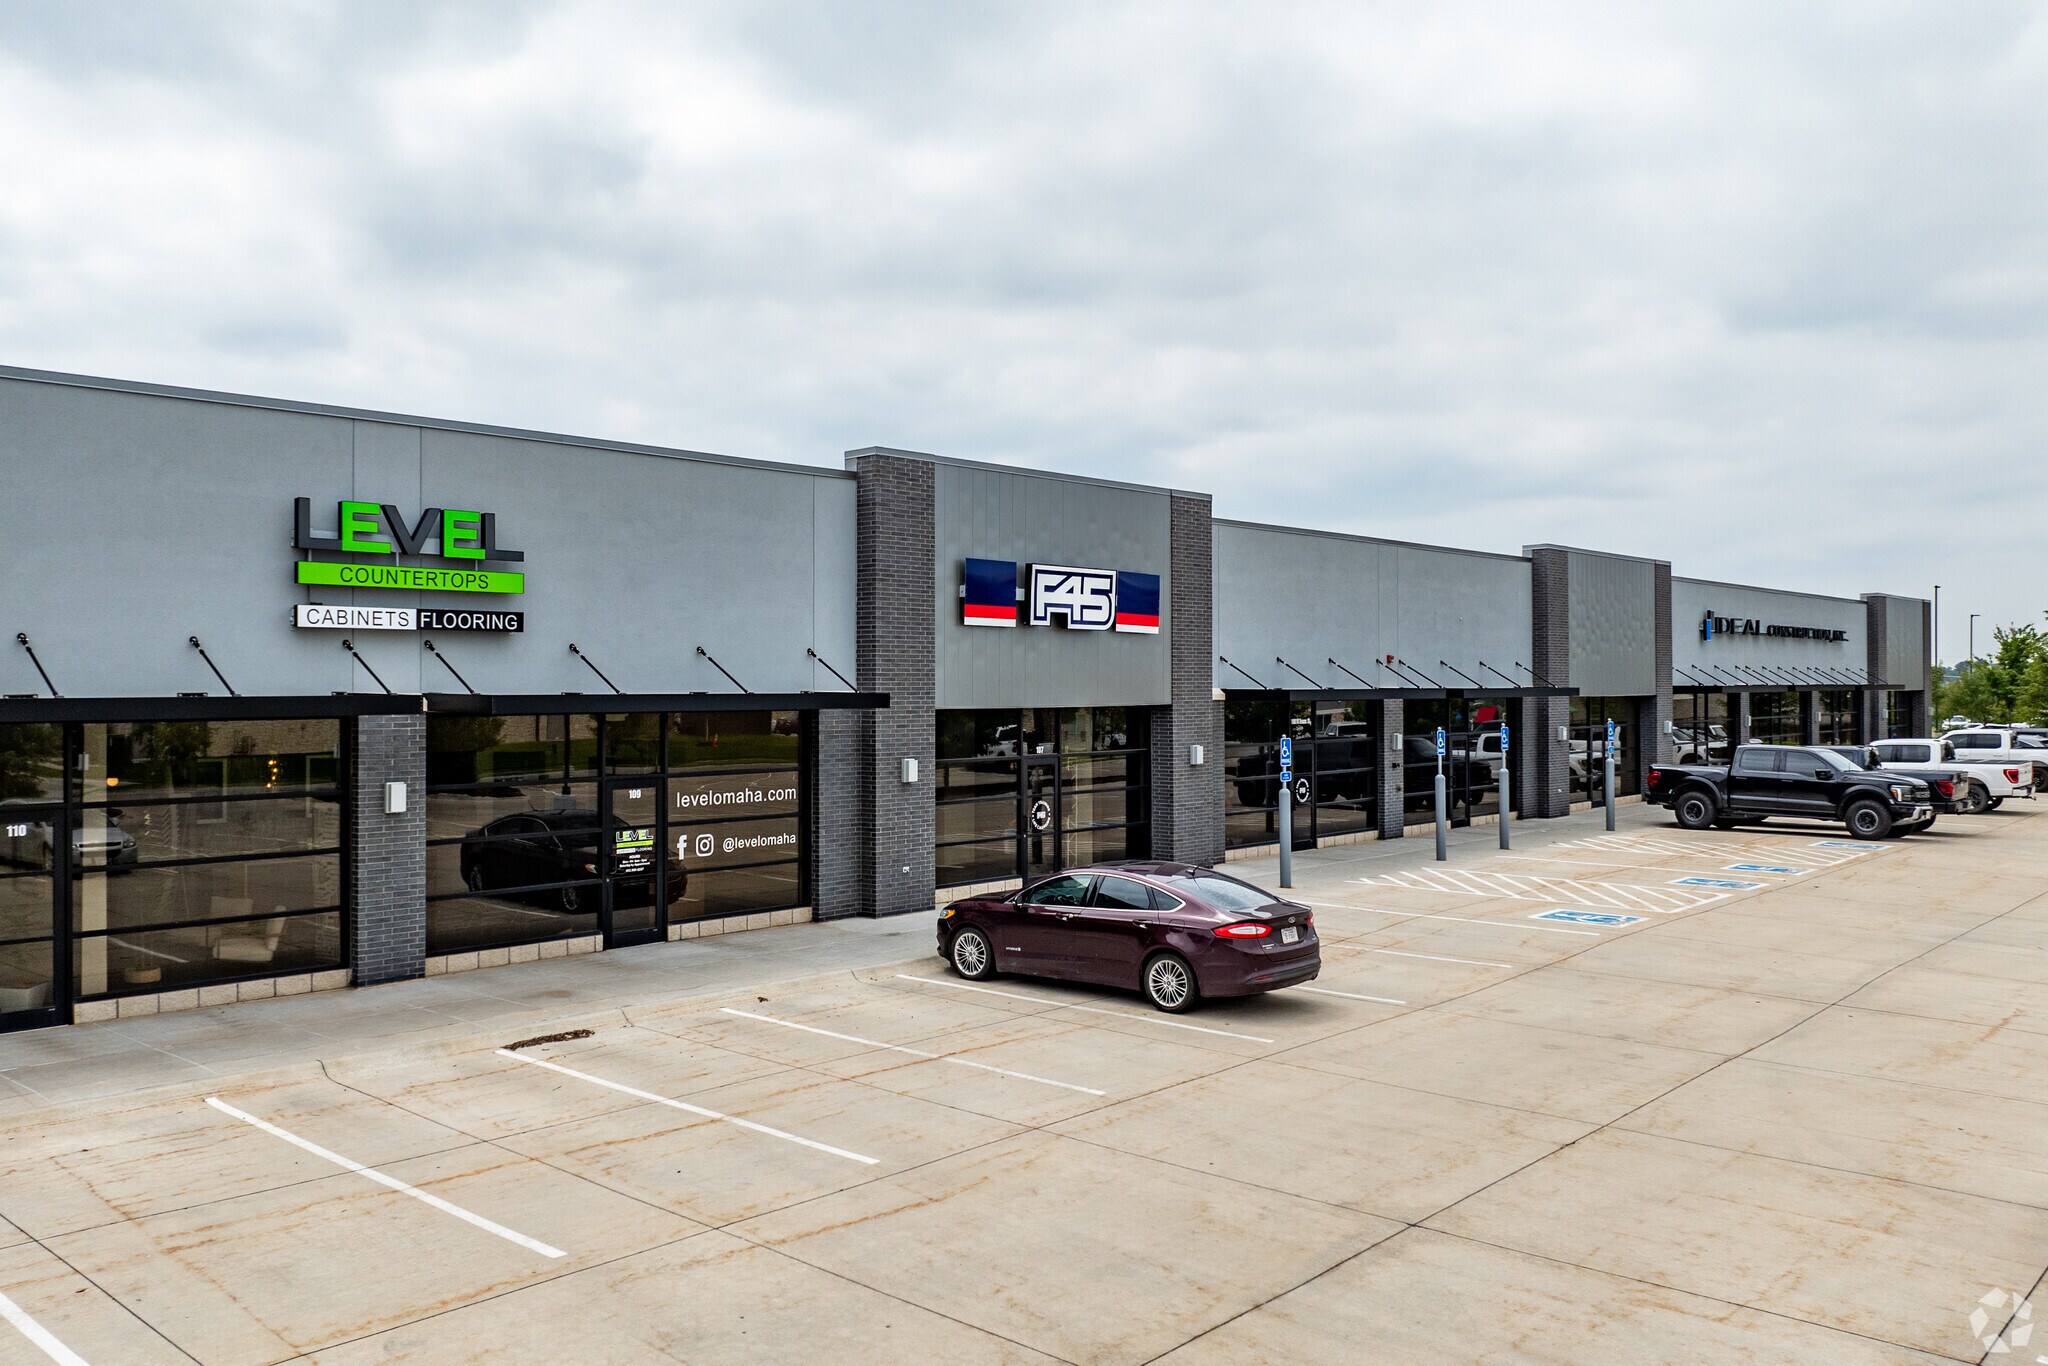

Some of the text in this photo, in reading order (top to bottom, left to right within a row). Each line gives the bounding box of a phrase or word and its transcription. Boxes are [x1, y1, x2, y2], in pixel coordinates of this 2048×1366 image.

[294, 497, 524, 562] LEVEL
[340, 566, 489, 590] COUNTERTOPS
[1036, 573, 1111, 622] F45
[306, 608, 518, 630] CABINETS FLOORING
[628, 789, 642, 799] 109
[676, 788, 797, 808] levelomaha.com
[6, 825, 27, 837] 110
[616, 829, 654, 842] LEVEL
[723, 832, 796, 853] @levelomaha
